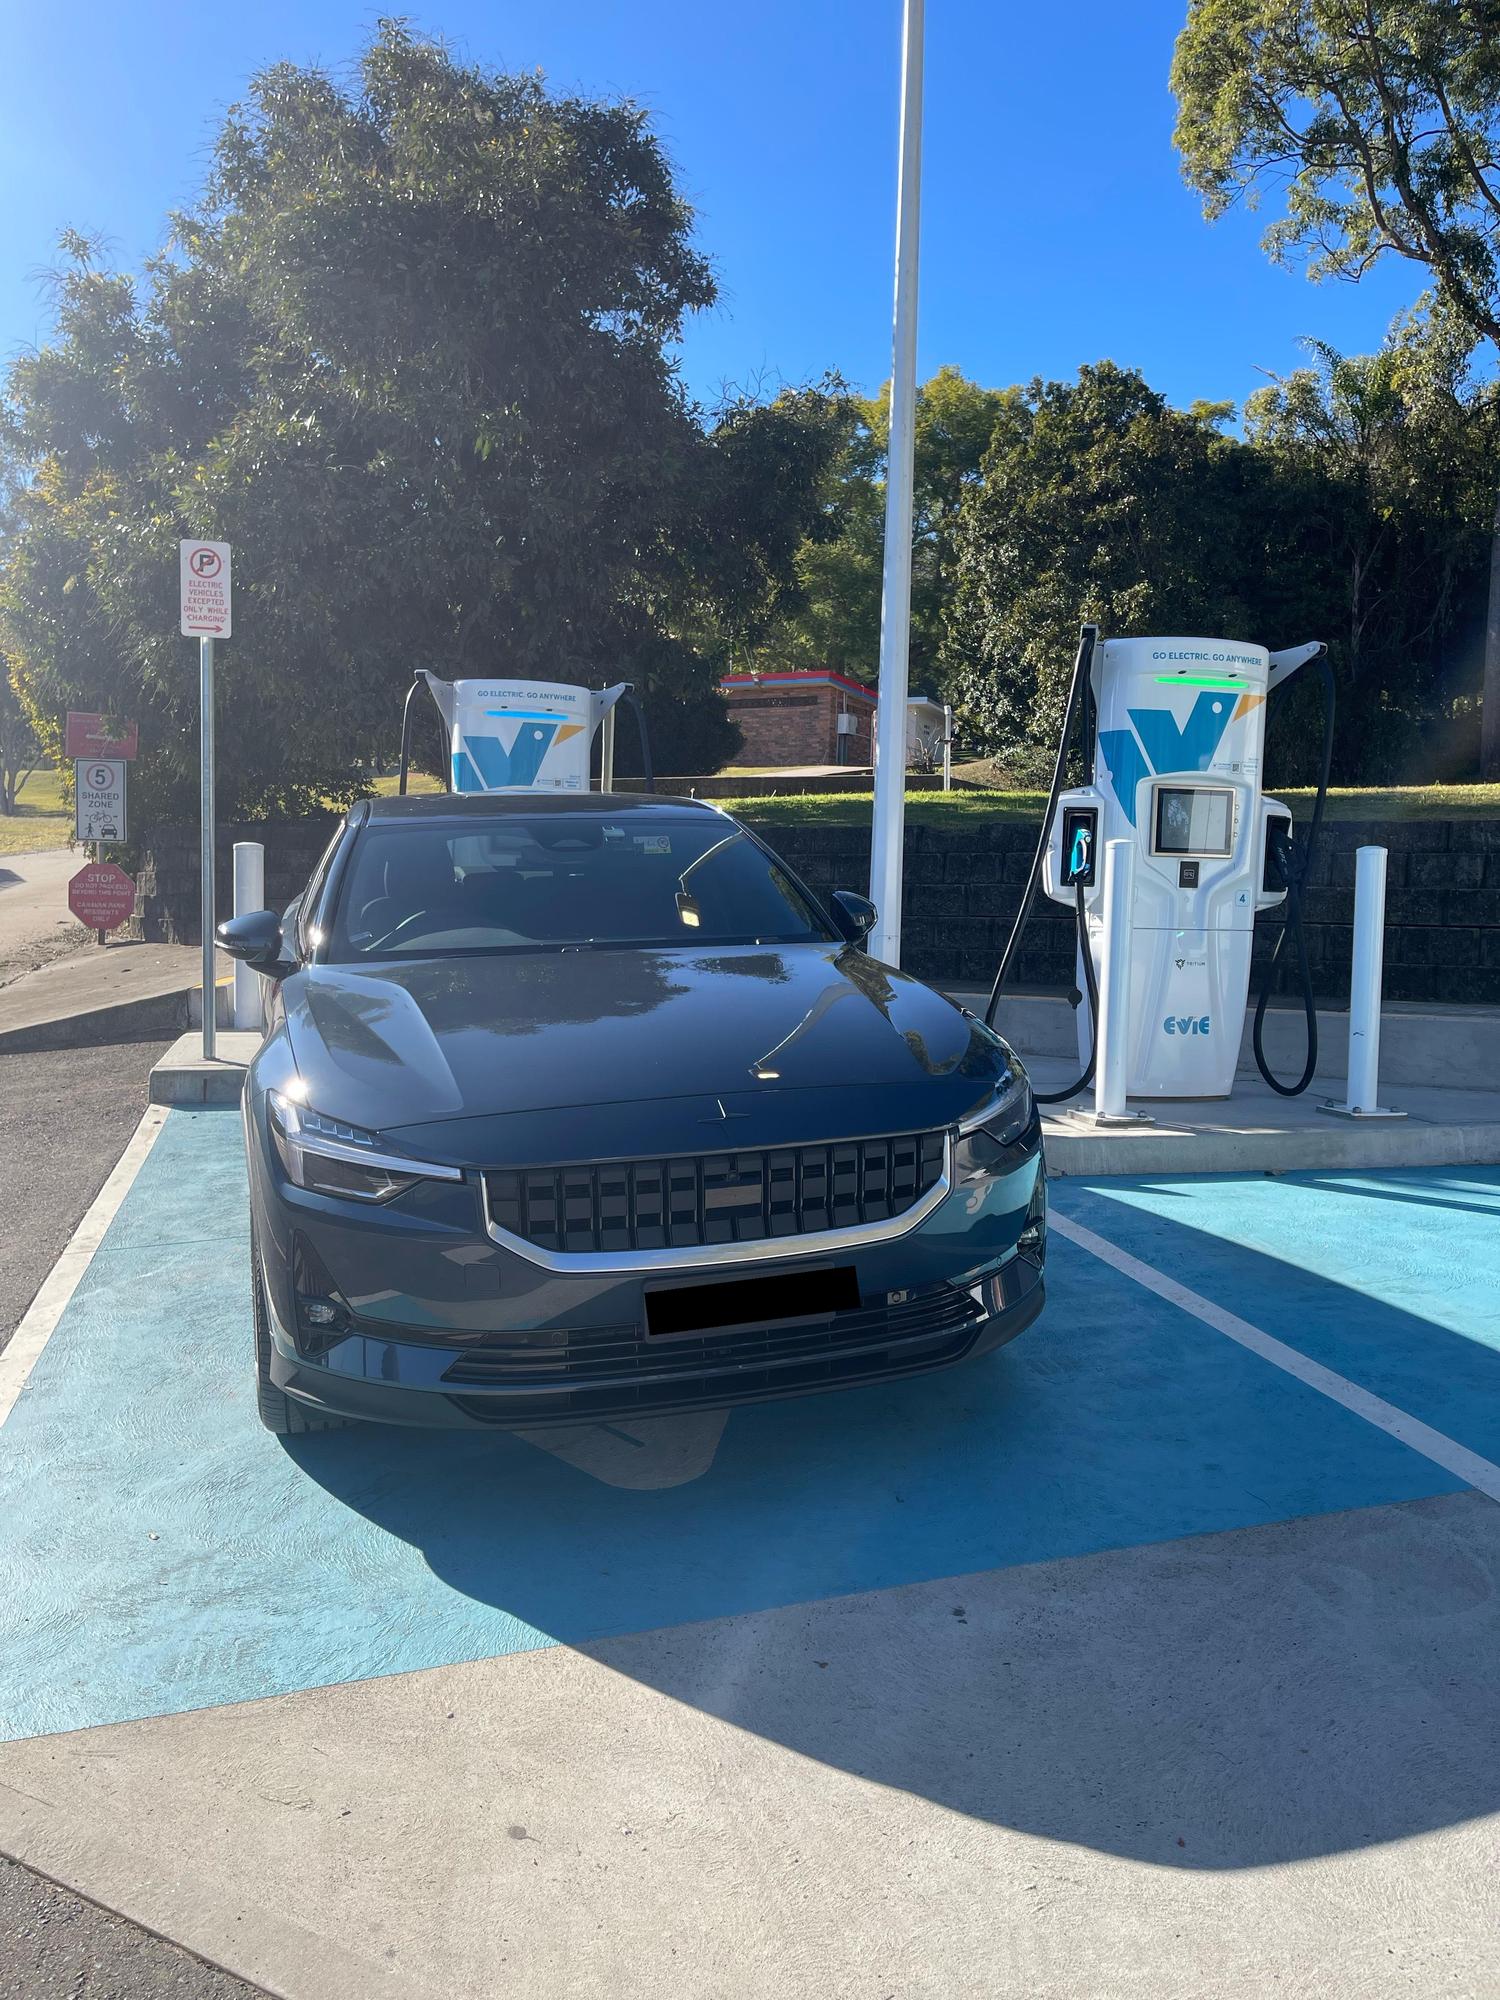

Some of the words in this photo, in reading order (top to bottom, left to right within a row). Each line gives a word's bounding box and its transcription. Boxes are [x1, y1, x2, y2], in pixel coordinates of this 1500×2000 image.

[188, 580, 223, 589] ELECTRIC
[189, 588, 224, 598] VEHICLES
[188, 597, 225, 606] EXCEPTED
[183, 605, 203, 614] ONLY
[207, 607, 229, 615] WHILE
[187, 614, 225, 623] CHARGING
[1152, 652, 1166, 660] GO
[1168, 652, 1211, 661] ELECTRIC.
[1212, 653, 1225, 662] GO
[1226, 654, 1262, 666] ANYWHERE
[477, 690, 489, 698] GO
[539, 693, 577, 702] ANYWHERE
[95, 769, 106, 785] 5
[81, 791, 119, 801] SHARED
[88, 800, 113, 809] ZONE
[87, 873, 116, 883] STOP
[1239, 894, 1246, 903] 4
